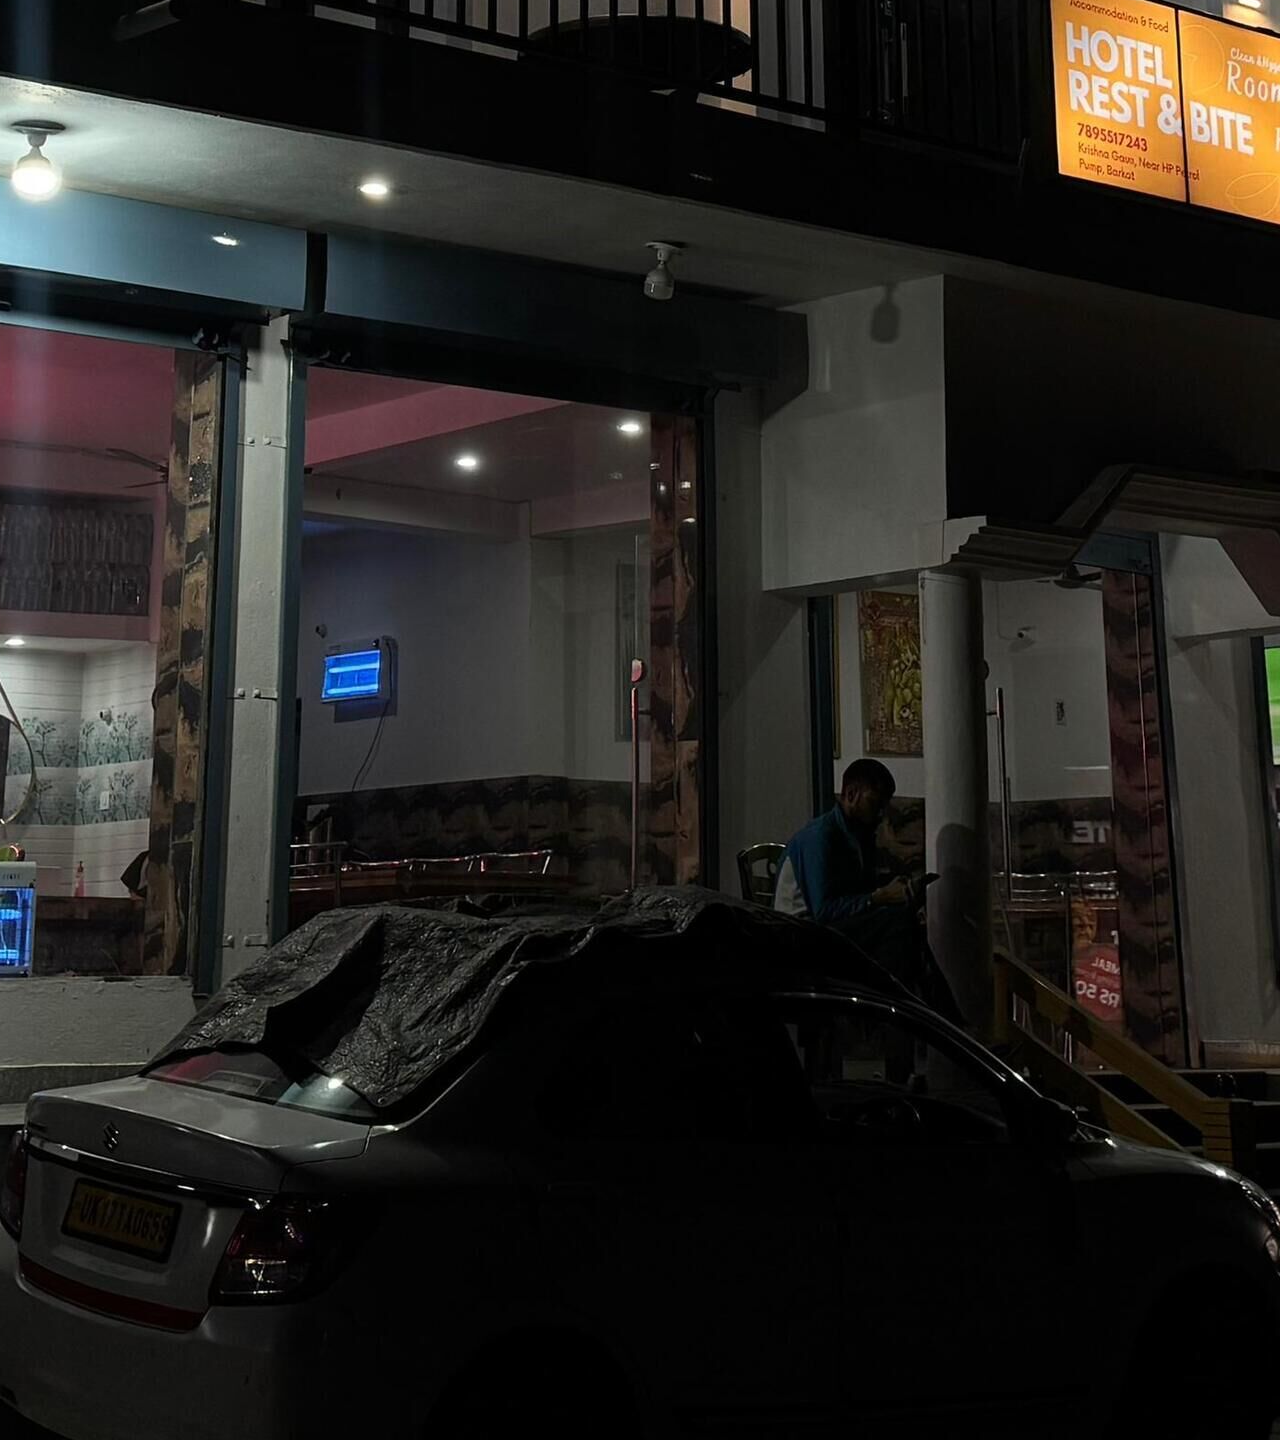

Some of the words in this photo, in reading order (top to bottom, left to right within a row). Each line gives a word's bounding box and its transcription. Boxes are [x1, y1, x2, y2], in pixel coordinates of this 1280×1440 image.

[1148, 18, 1169, 33] Food
[1065, 21, 1173, 89] HOTEL
[1068, 69, 1150, 128] REST
[1157, 93, 1184, 137] &
[1189, 100, 1255, 156] BITE
[1077, 122, 1149, 152] 7895517243
[1078, 142, 1109, 160] Krishna
[1138, 157, 1160, 172] Near
[1162, 162, 1175, 174] HP
[1176, 165, 1200, 181] Perol
[1079, 158, 1105, 176] Pump,
[1107, 165, 1135, 181] Barkot
